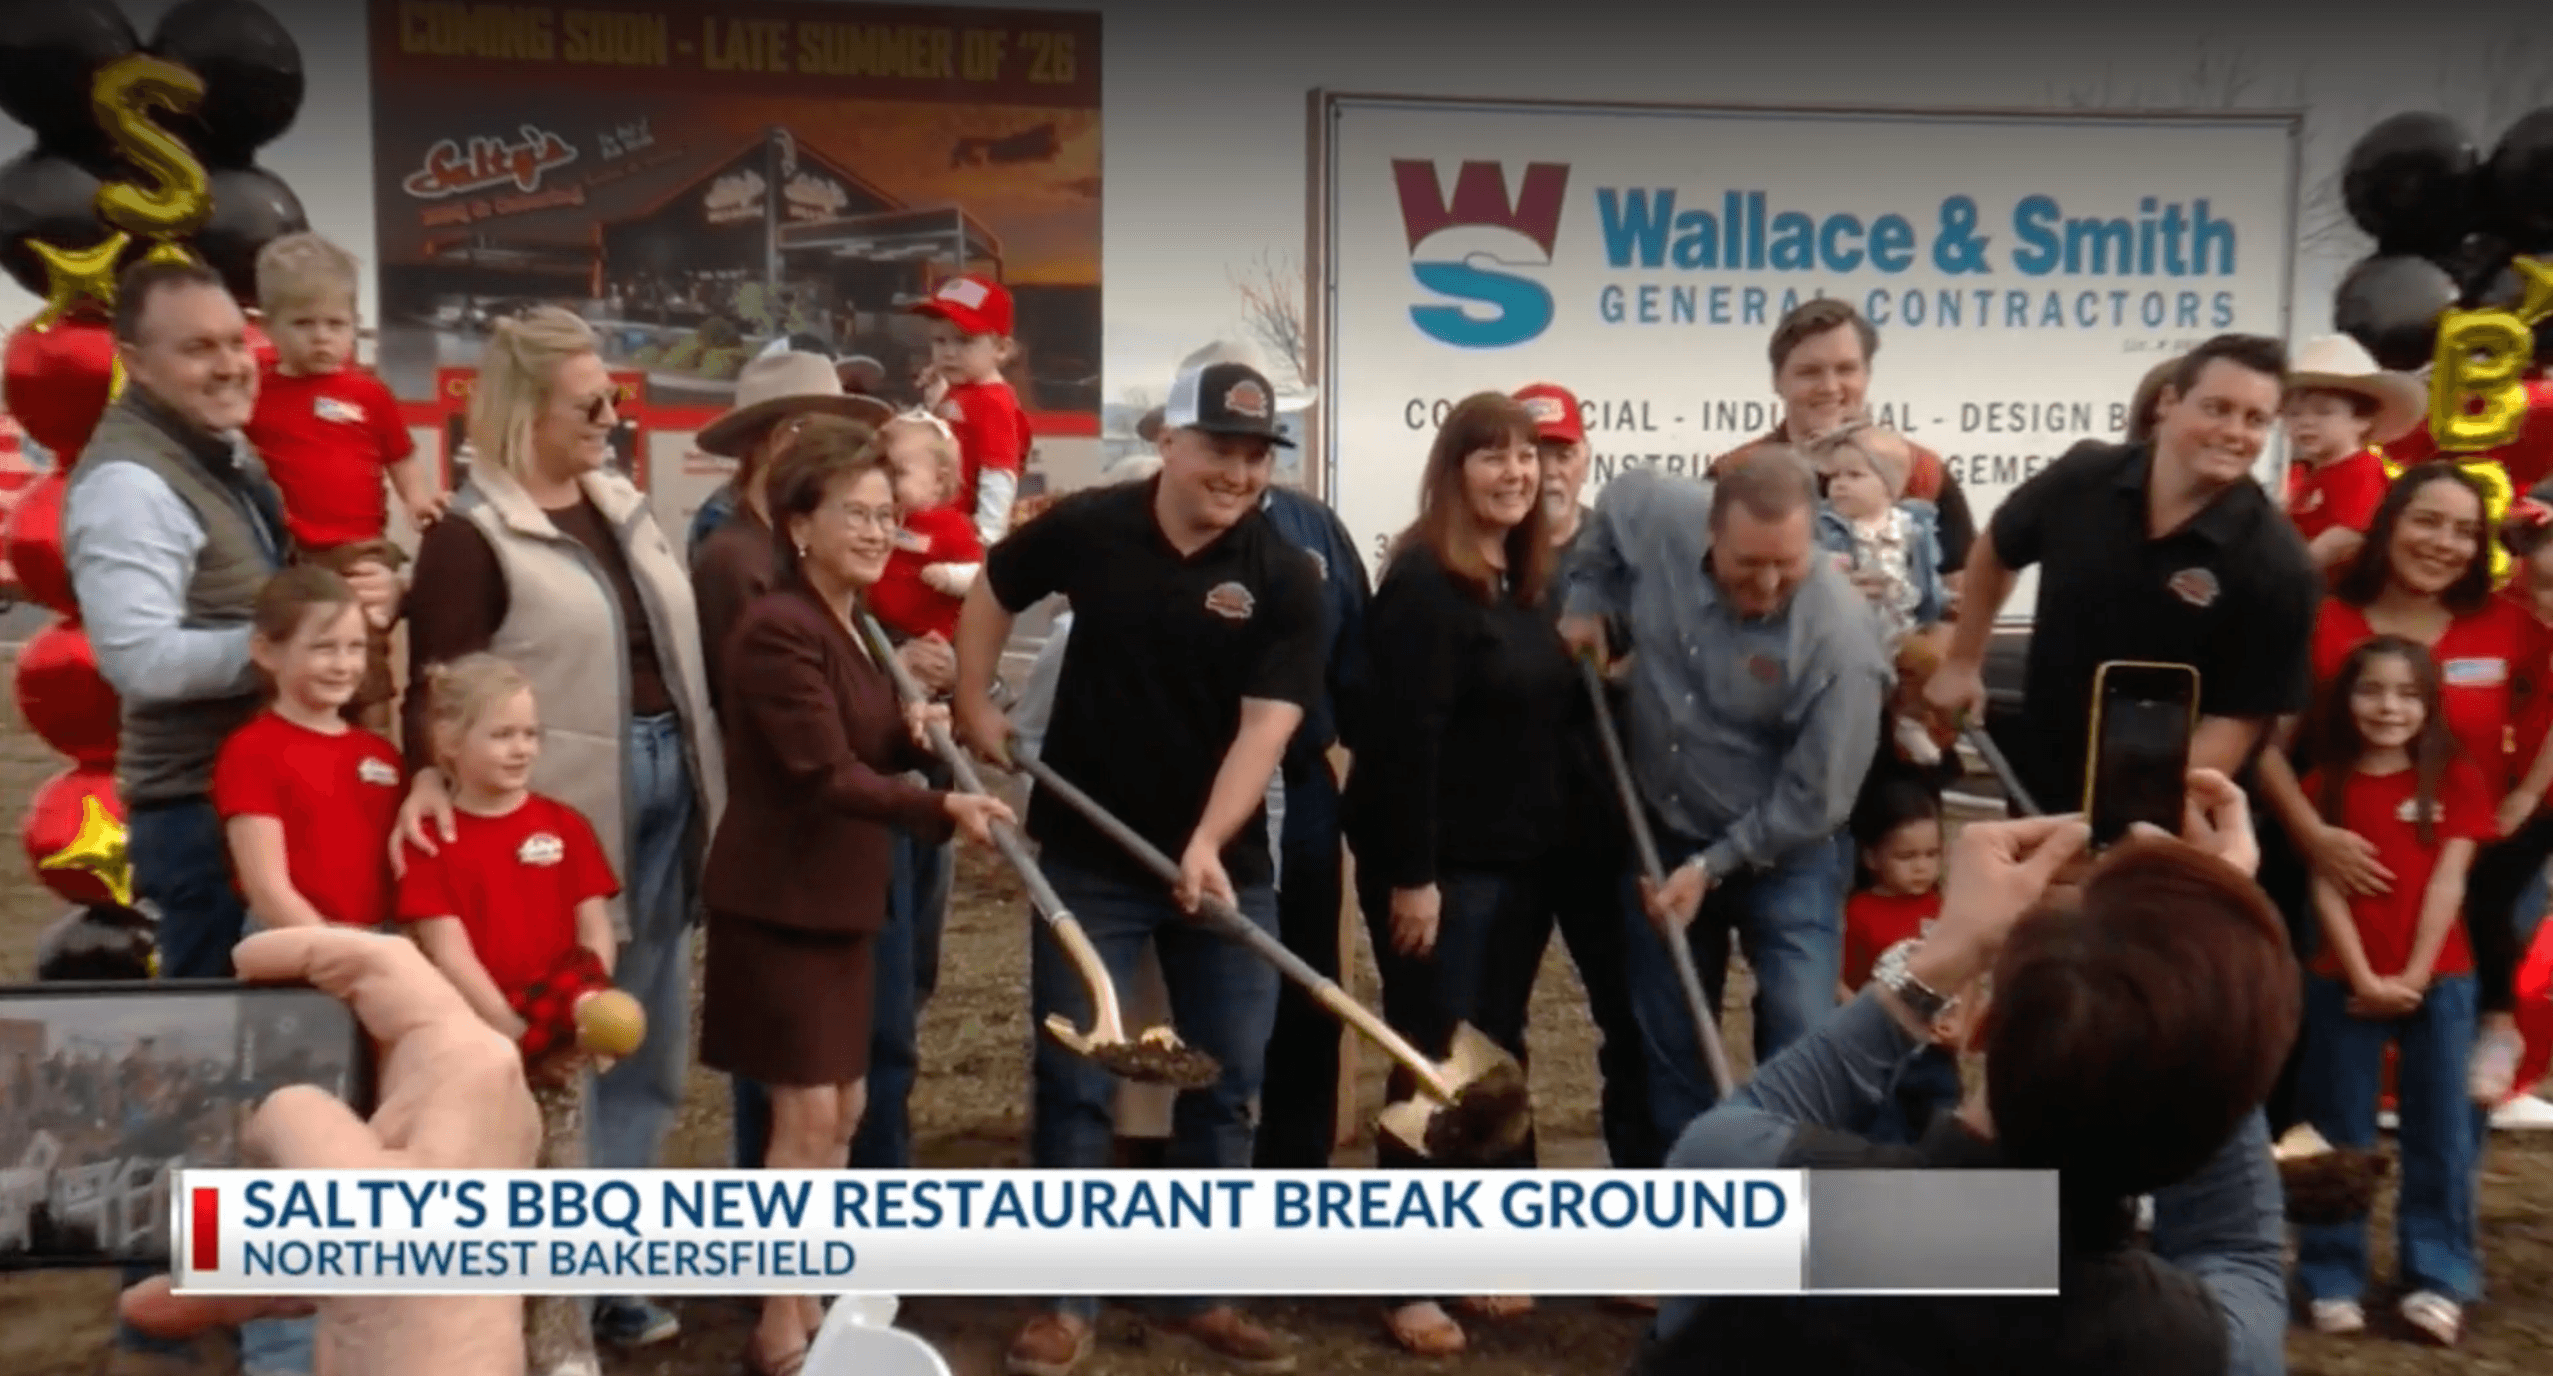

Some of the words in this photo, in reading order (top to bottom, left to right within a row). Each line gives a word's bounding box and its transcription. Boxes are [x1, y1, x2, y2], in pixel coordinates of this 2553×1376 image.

[400, 2, 555, 60] COMING
[563, 8, 669, 67] SOON
[702, 14, 790, 73] LATE
[797, 20, 955, 79] SUMMER
[962, 28, 1008, 81] OF
[1596, 187, 1916, 273] Wallace
[1932, 194, 1995, 275] &
[2011, 193, 2236, 276] Smith
[1600, 283, 1824, 325] GENERA
[1865, 287, 2235, 329] CONTRACTORS
[1961, 402, 2092, 433] DESIGN
